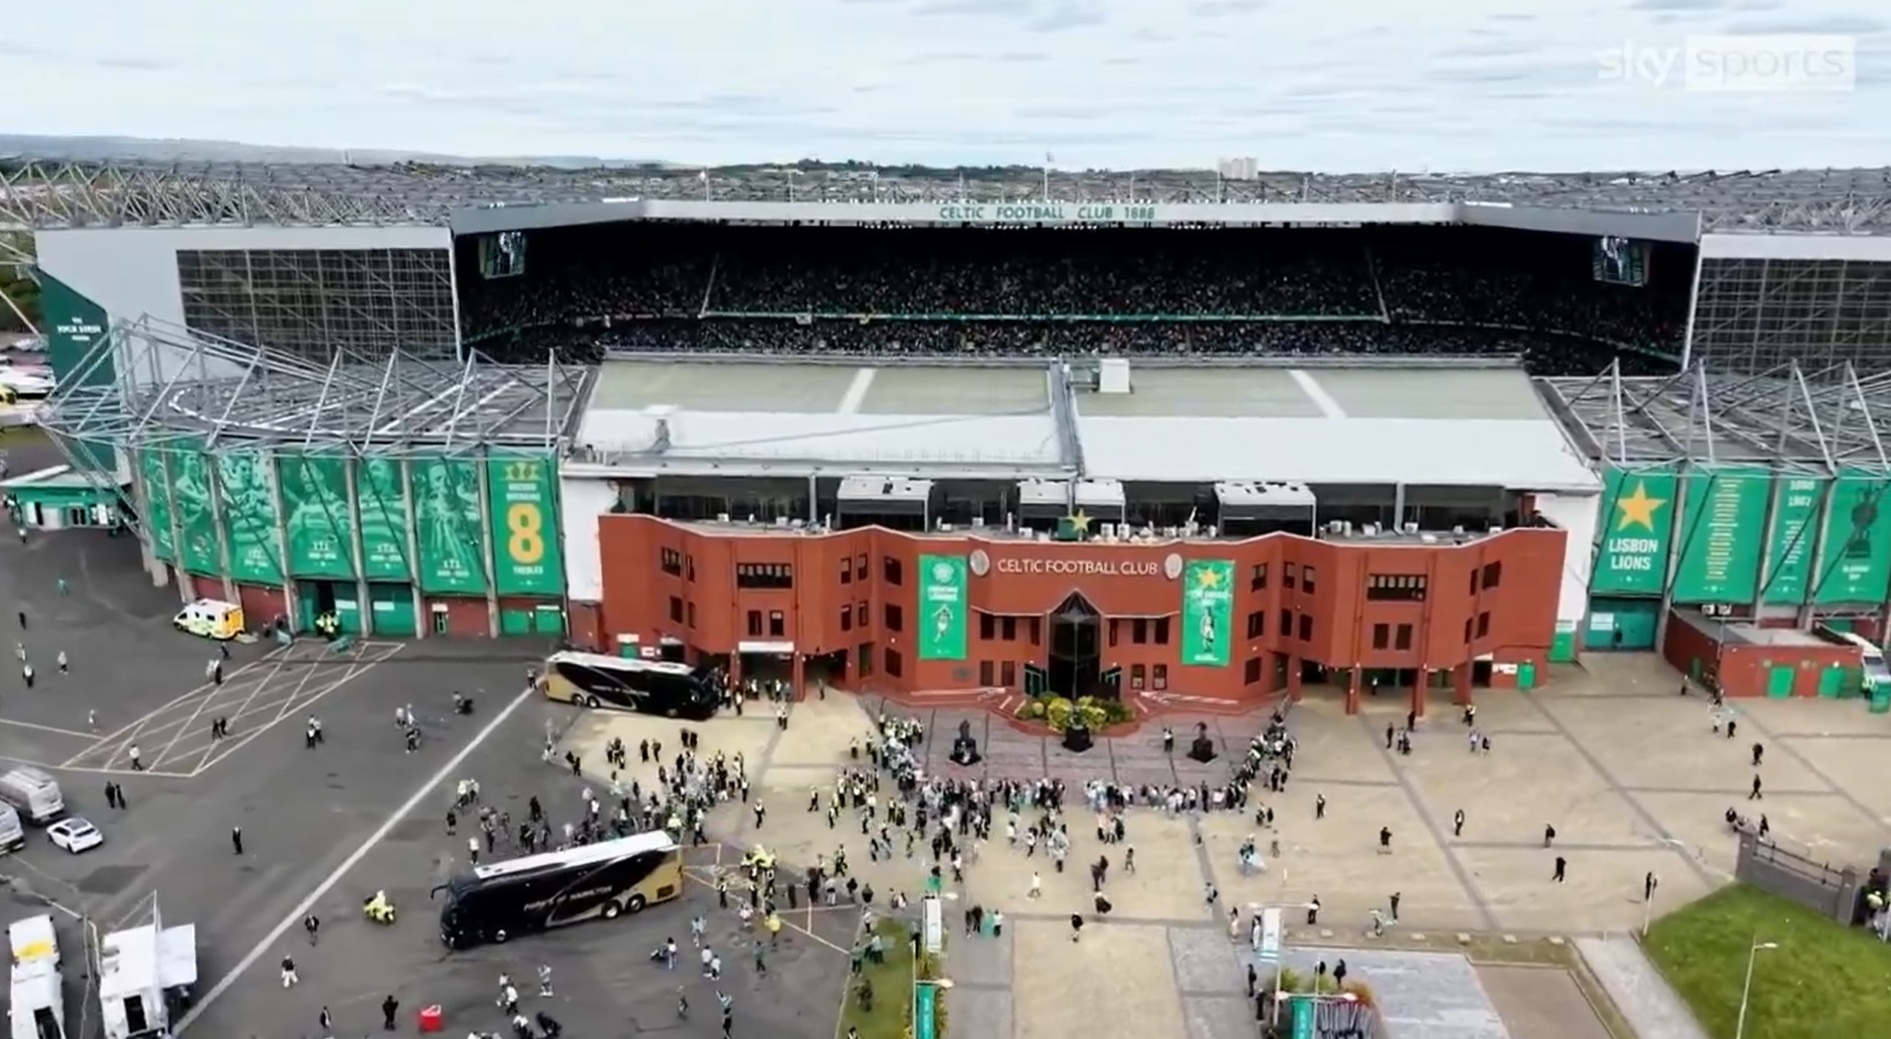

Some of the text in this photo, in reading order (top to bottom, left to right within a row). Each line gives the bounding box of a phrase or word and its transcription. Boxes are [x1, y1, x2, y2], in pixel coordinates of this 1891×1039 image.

[939, 206, 984, 218] CELTIC
[996, 206, 1064, 218] FOOTBALL
[1077, 206, 1113, 218] CLUB
[507, 502, 544, 565] 8
[1608, 537, 1659, 553] LISBON
[997, 558, 1158, 576] CELTIC FOOTBALL CLUB
[1611, 554, 1651, 571] LIONS
